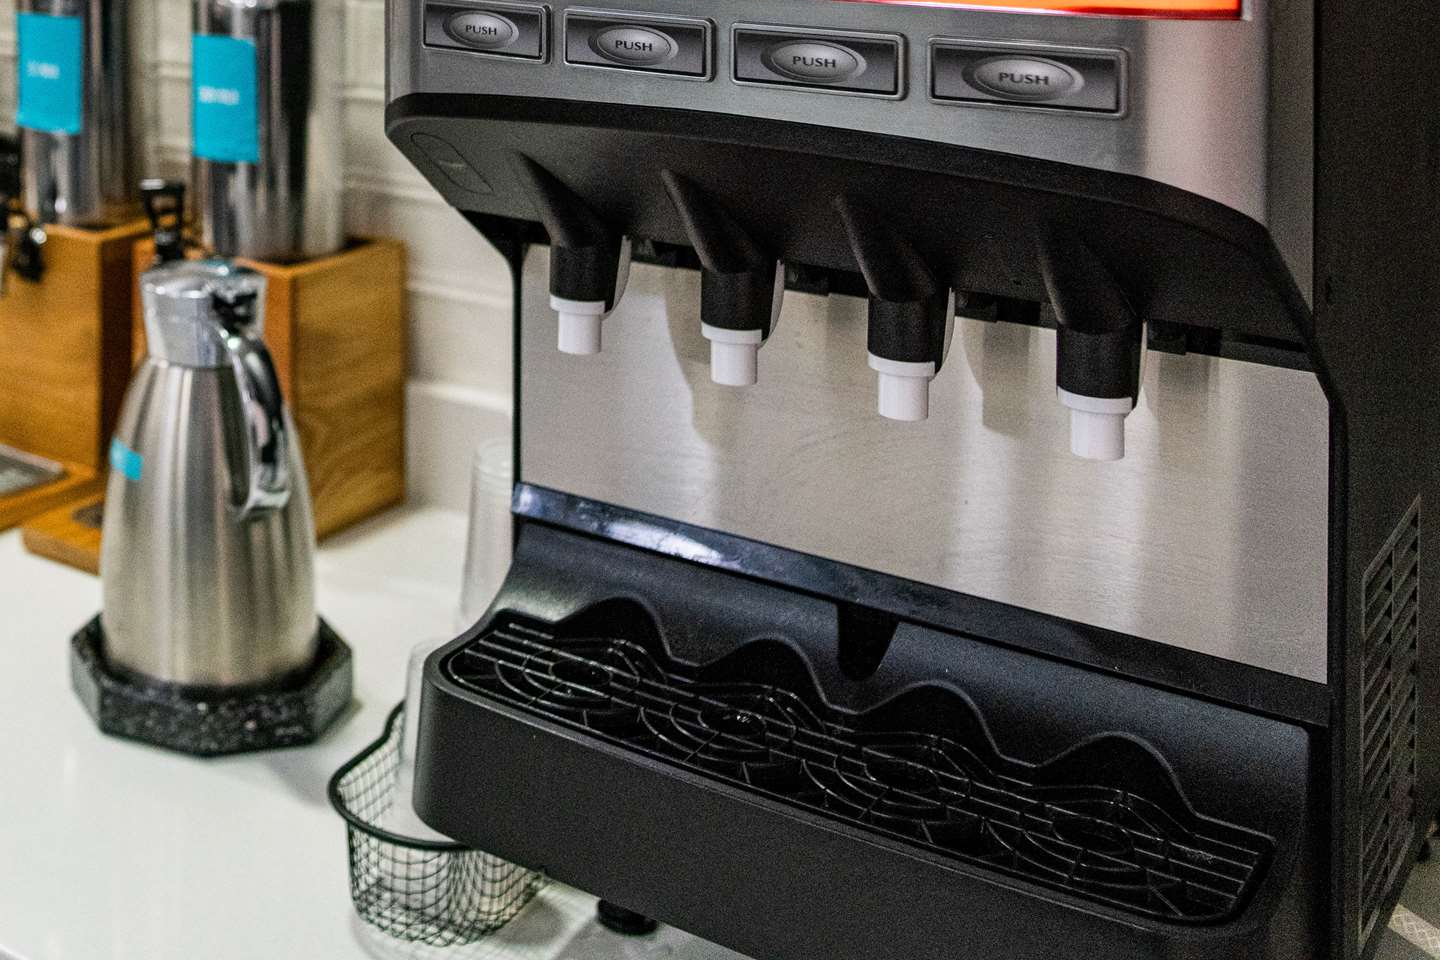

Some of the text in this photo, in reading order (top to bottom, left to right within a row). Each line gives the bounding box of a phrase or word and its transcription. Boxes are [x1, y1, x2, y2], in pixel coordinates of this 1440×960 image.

[465, 24, 497, 37] PUSH
[615, 40, 653, 53] PUSH
[792, 55, 836, 69] PUSH
[998, 71, 1050, 87] PUSH
